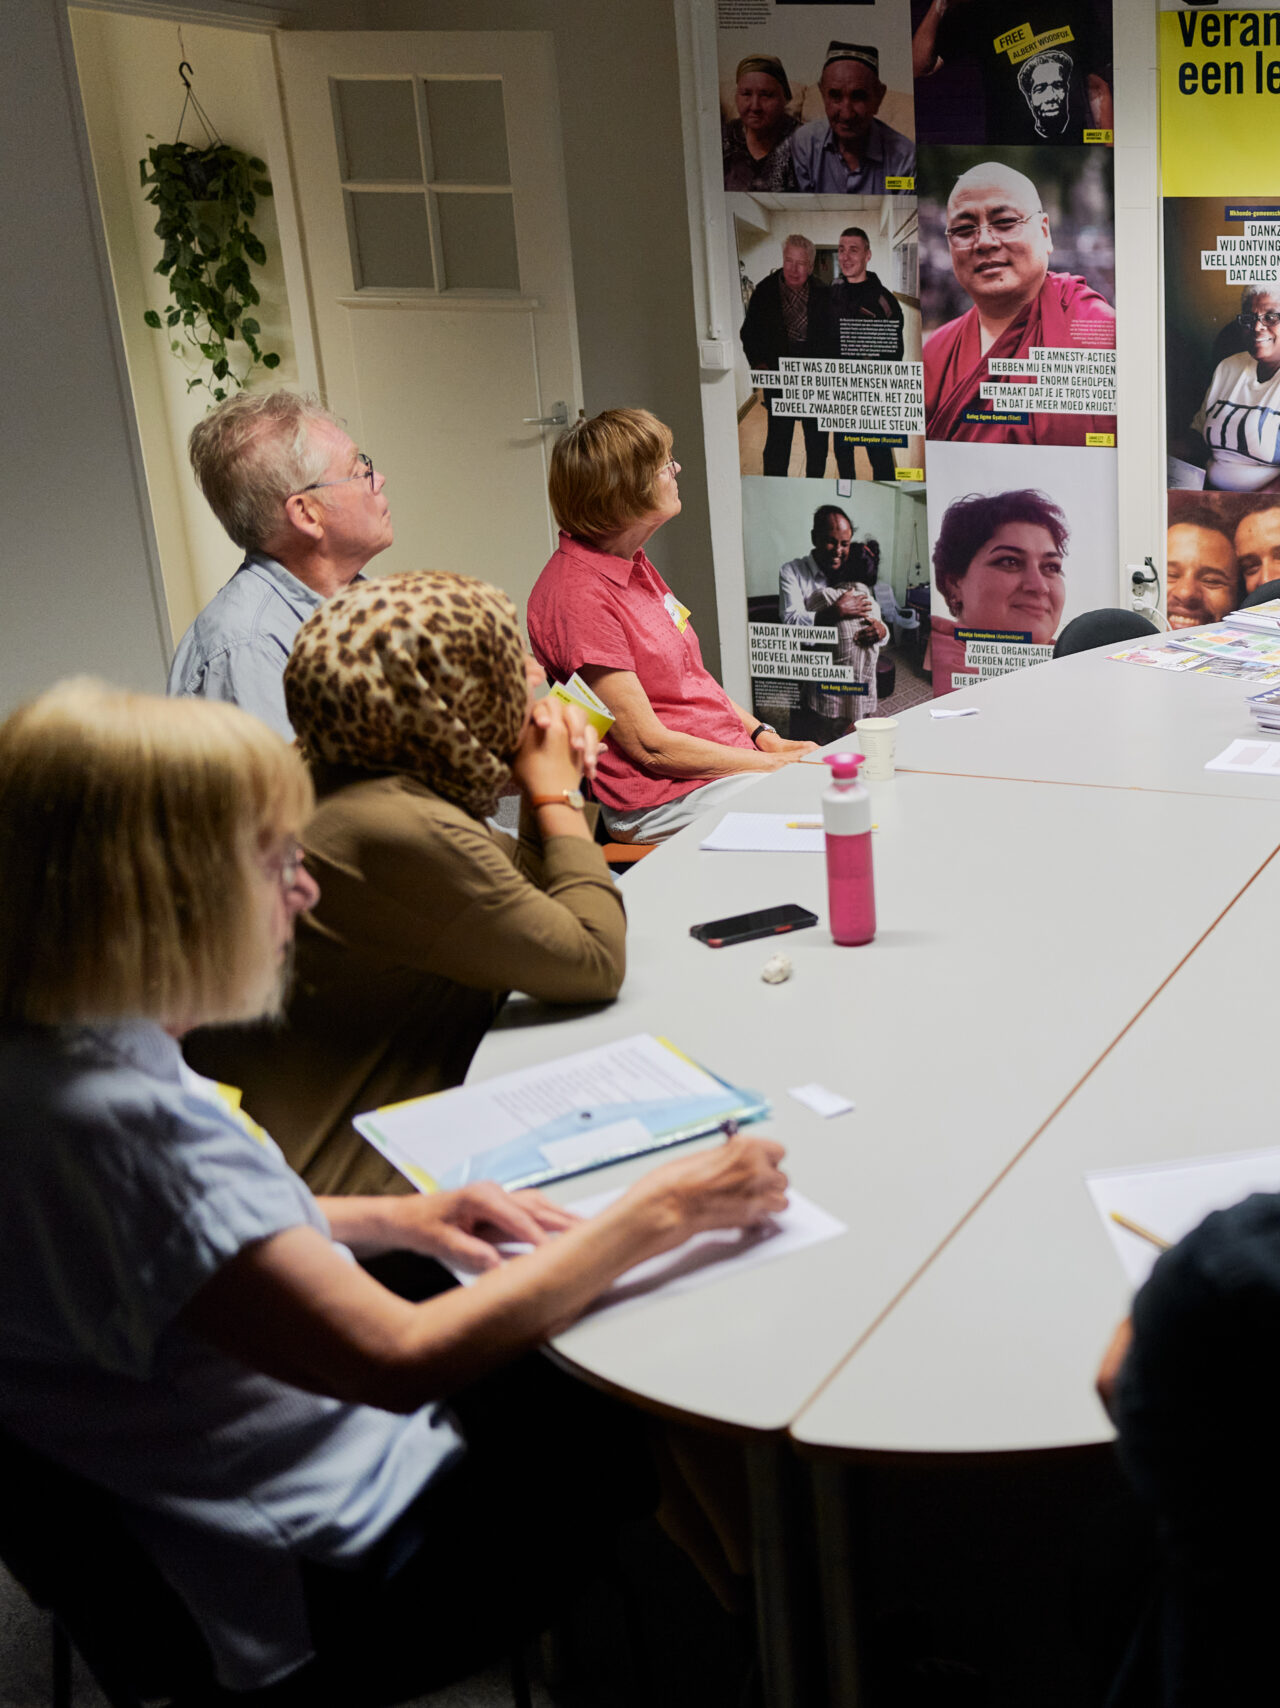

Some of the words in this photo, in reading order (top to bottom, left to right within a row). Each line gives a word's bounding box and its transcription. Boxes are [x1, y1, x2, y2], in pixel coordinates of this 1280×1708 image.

[999, 29, 1026, 48] FREE
[1012, 42, 1037, 59] ALBERT
[1038, 31, 1070, 46] WOODFOX
[1179, 61, 1244, 95] een
[1220, 240, 1236, 251] WIJ
[1205, 255, 1227, 266] VEEL
[1229, 255, 1267, 266] LANDEN
[1230, 270, 1246, 281] DAT
[1249, 270, 1277, 281] ALLES
[1047, 351, 1116, 363] AMNESTY-ACTIES
[782, 361, 800, 373] 'HET
[803, 362, 822, 373] WAS
[825, 363, 837, 373] ZO
[839, 363, 892, 375] BELANGRIJK
[895, 365, 909, 375] OM
[911, 365, 921, 376] TE
[992, 362, 1024, 372] HEBBEN
[1027, 363, 1039, 373] MIJ
[1042, 363, 1051, 373] EN
[1054, 363, 1073, 373] MIJN
[1075, 364, 1116, 375] VRIENDEN
[751, 374, 781, 385] WETEN
[783, 375, 799, 385] DAT
[801, 375, 813, 386] ER
[816, 376, 848, 387] BUITEN
[850, 377, 887, 388] MENSEN
[890, 379, 922, 390] WAREN
[1041, 375, 1069, 386] ENORM
[1071, 376, 1116, 387] GEHOLPEN.
[786, 389, 800, 399] DIE
[803, 390, 815, 399] OP
[817, 390, 830, 401] ME
[833, 391, 883, 403] WACHTTEN.
[885, 392, 902, 403] HET
[904, 393, 922, 404] ZOU
[775, 402, 807, 414] ZOVEEL
[809, 403, 858, 415] ZWAARDER
[861, 405, 902, 416] GEWEEST
[904, 407, 923, 417] ZIJN
[820, 418, 856, 429] ZONDER
[859, 419, 887, 430] JULLIE
[889, 419, 924, 431] STEUN.'
[750, 626, 779, 637] 'NADAT
[782, 627, 790, 637] IK
[792, 628, 835, 640] VRIJKWAM
[751, 638, 786, 649] BESEFTE
[789, 640, 798, 650] IK
[751, 651, 789, 663] HOEVEEL
[791, 653, 830, 665] AMNESTY
[967, 656, 1003, 665] VOERDEN
[1005, 657, 1026, 667] ACTIE
[752, 664, 775, 674] VOOR
[777, 665, 791, 676] MIJ
[793, 666, 809, 677] HAD
[812, 667, 851, 679] GEDAAN.'
